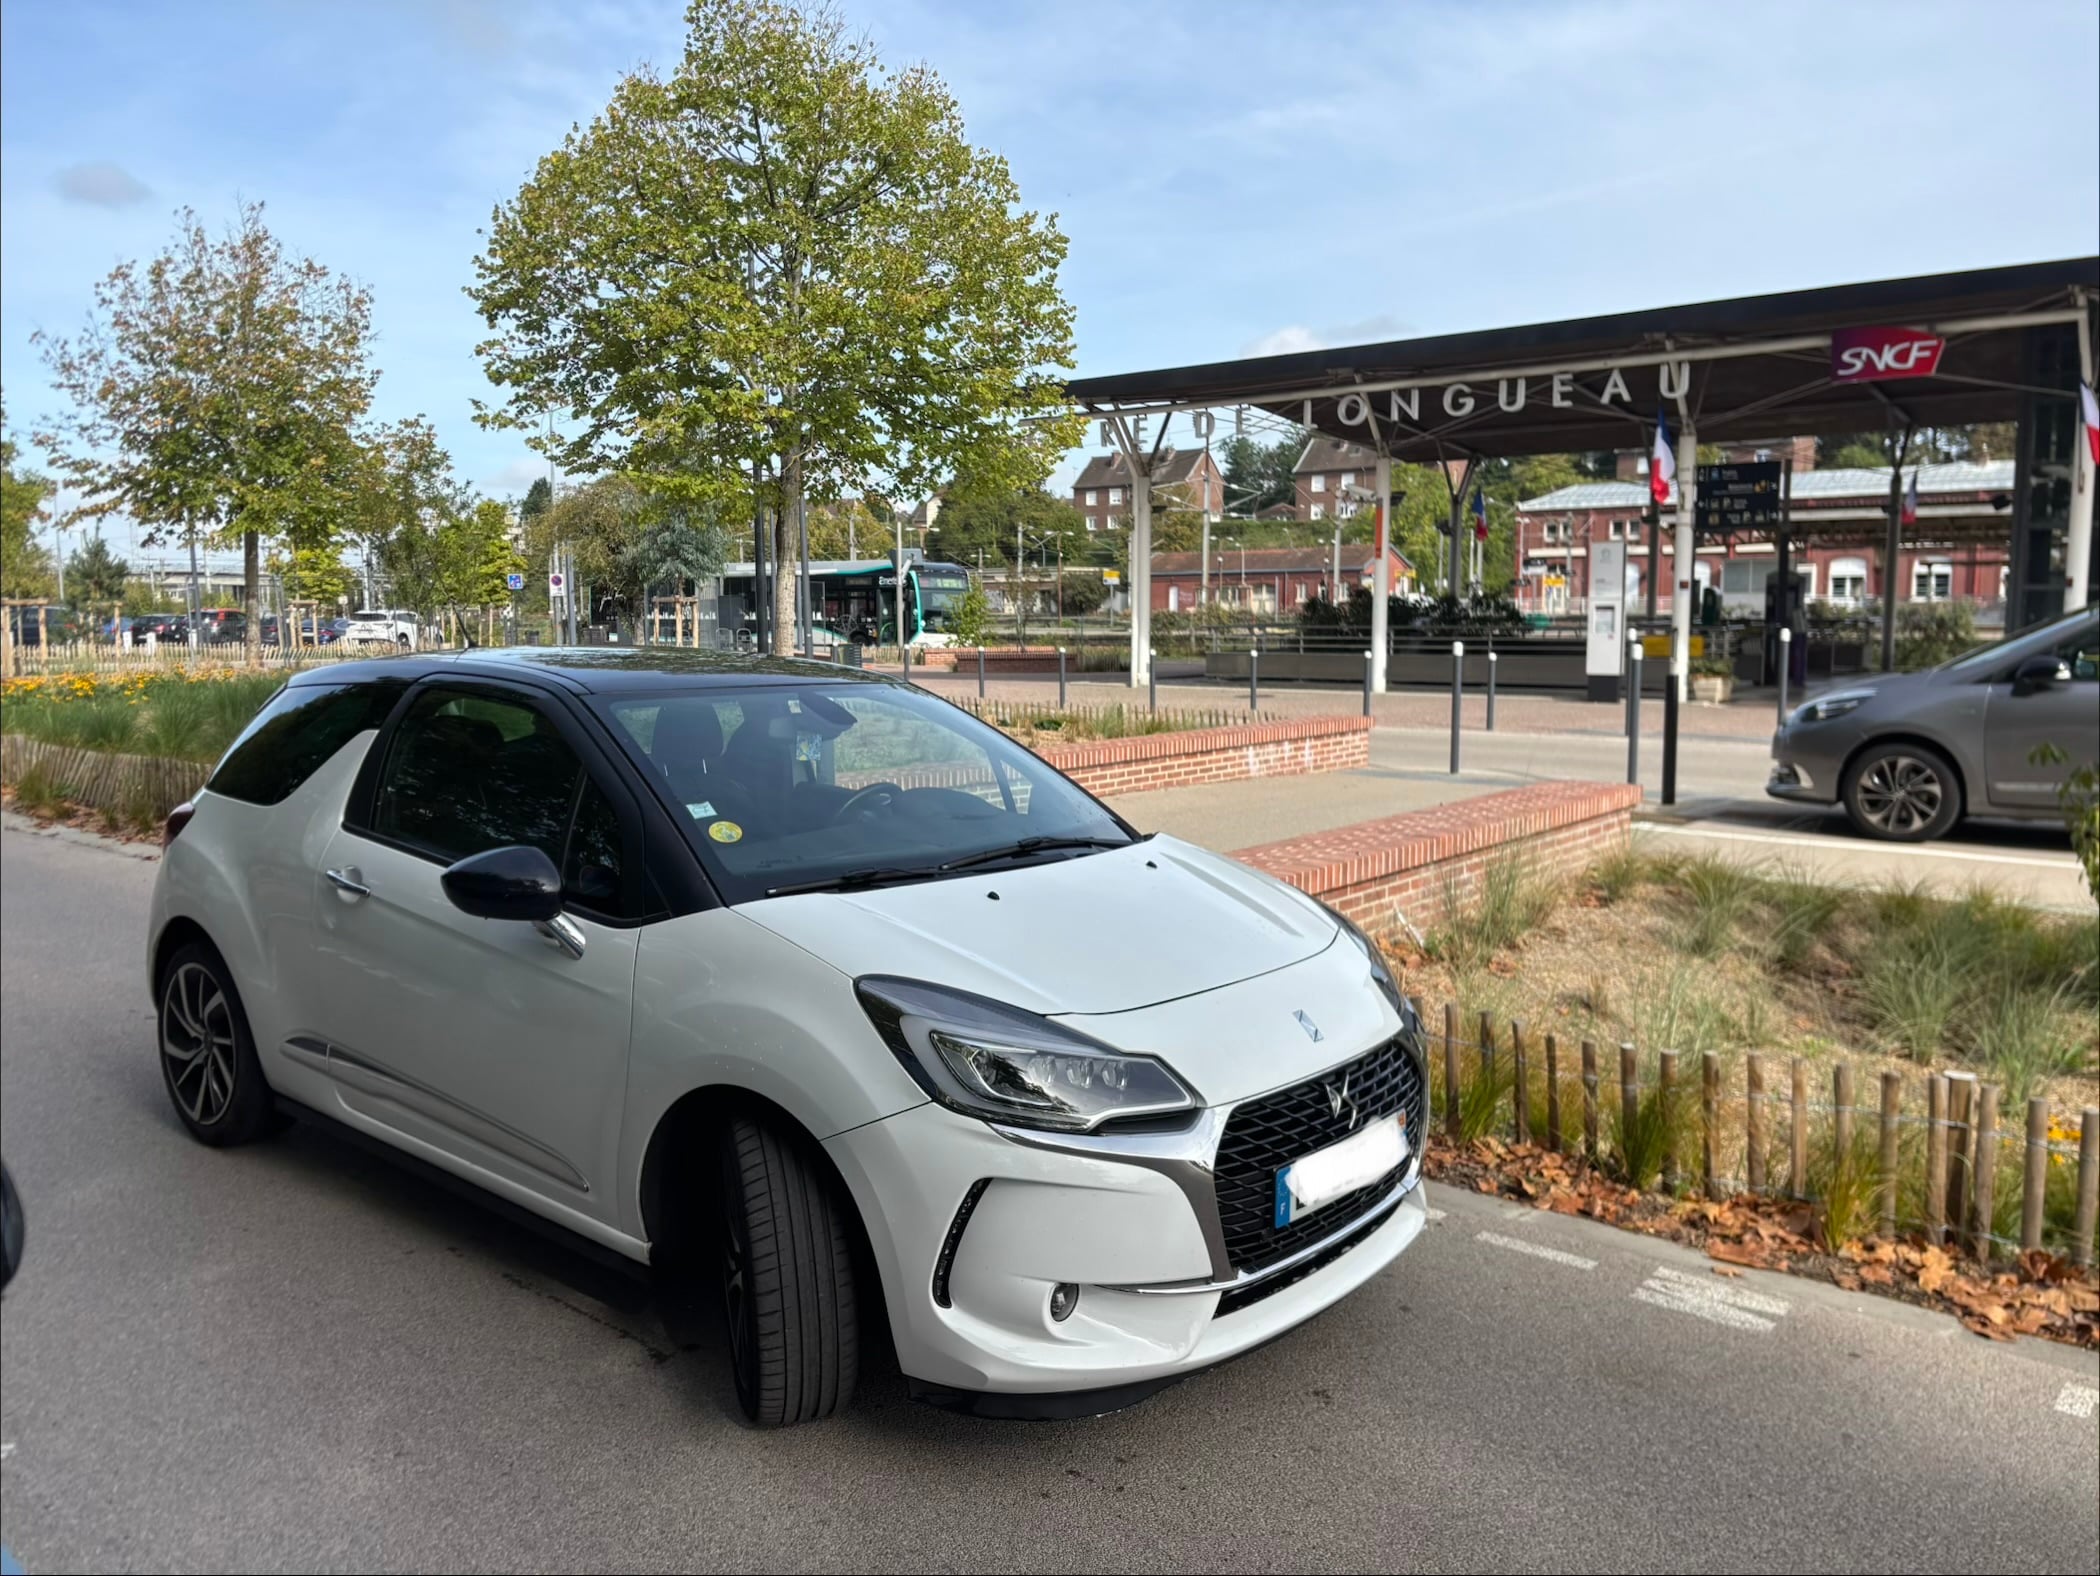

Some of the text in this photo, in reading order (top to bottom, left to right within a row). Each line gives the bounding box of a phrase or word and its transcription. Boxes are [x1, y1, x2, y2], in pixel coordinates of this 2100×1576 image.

[1837, 340, 1938, 376] SNCF
[1100, 363, 1690, 447] RE DE LONGUEAU
